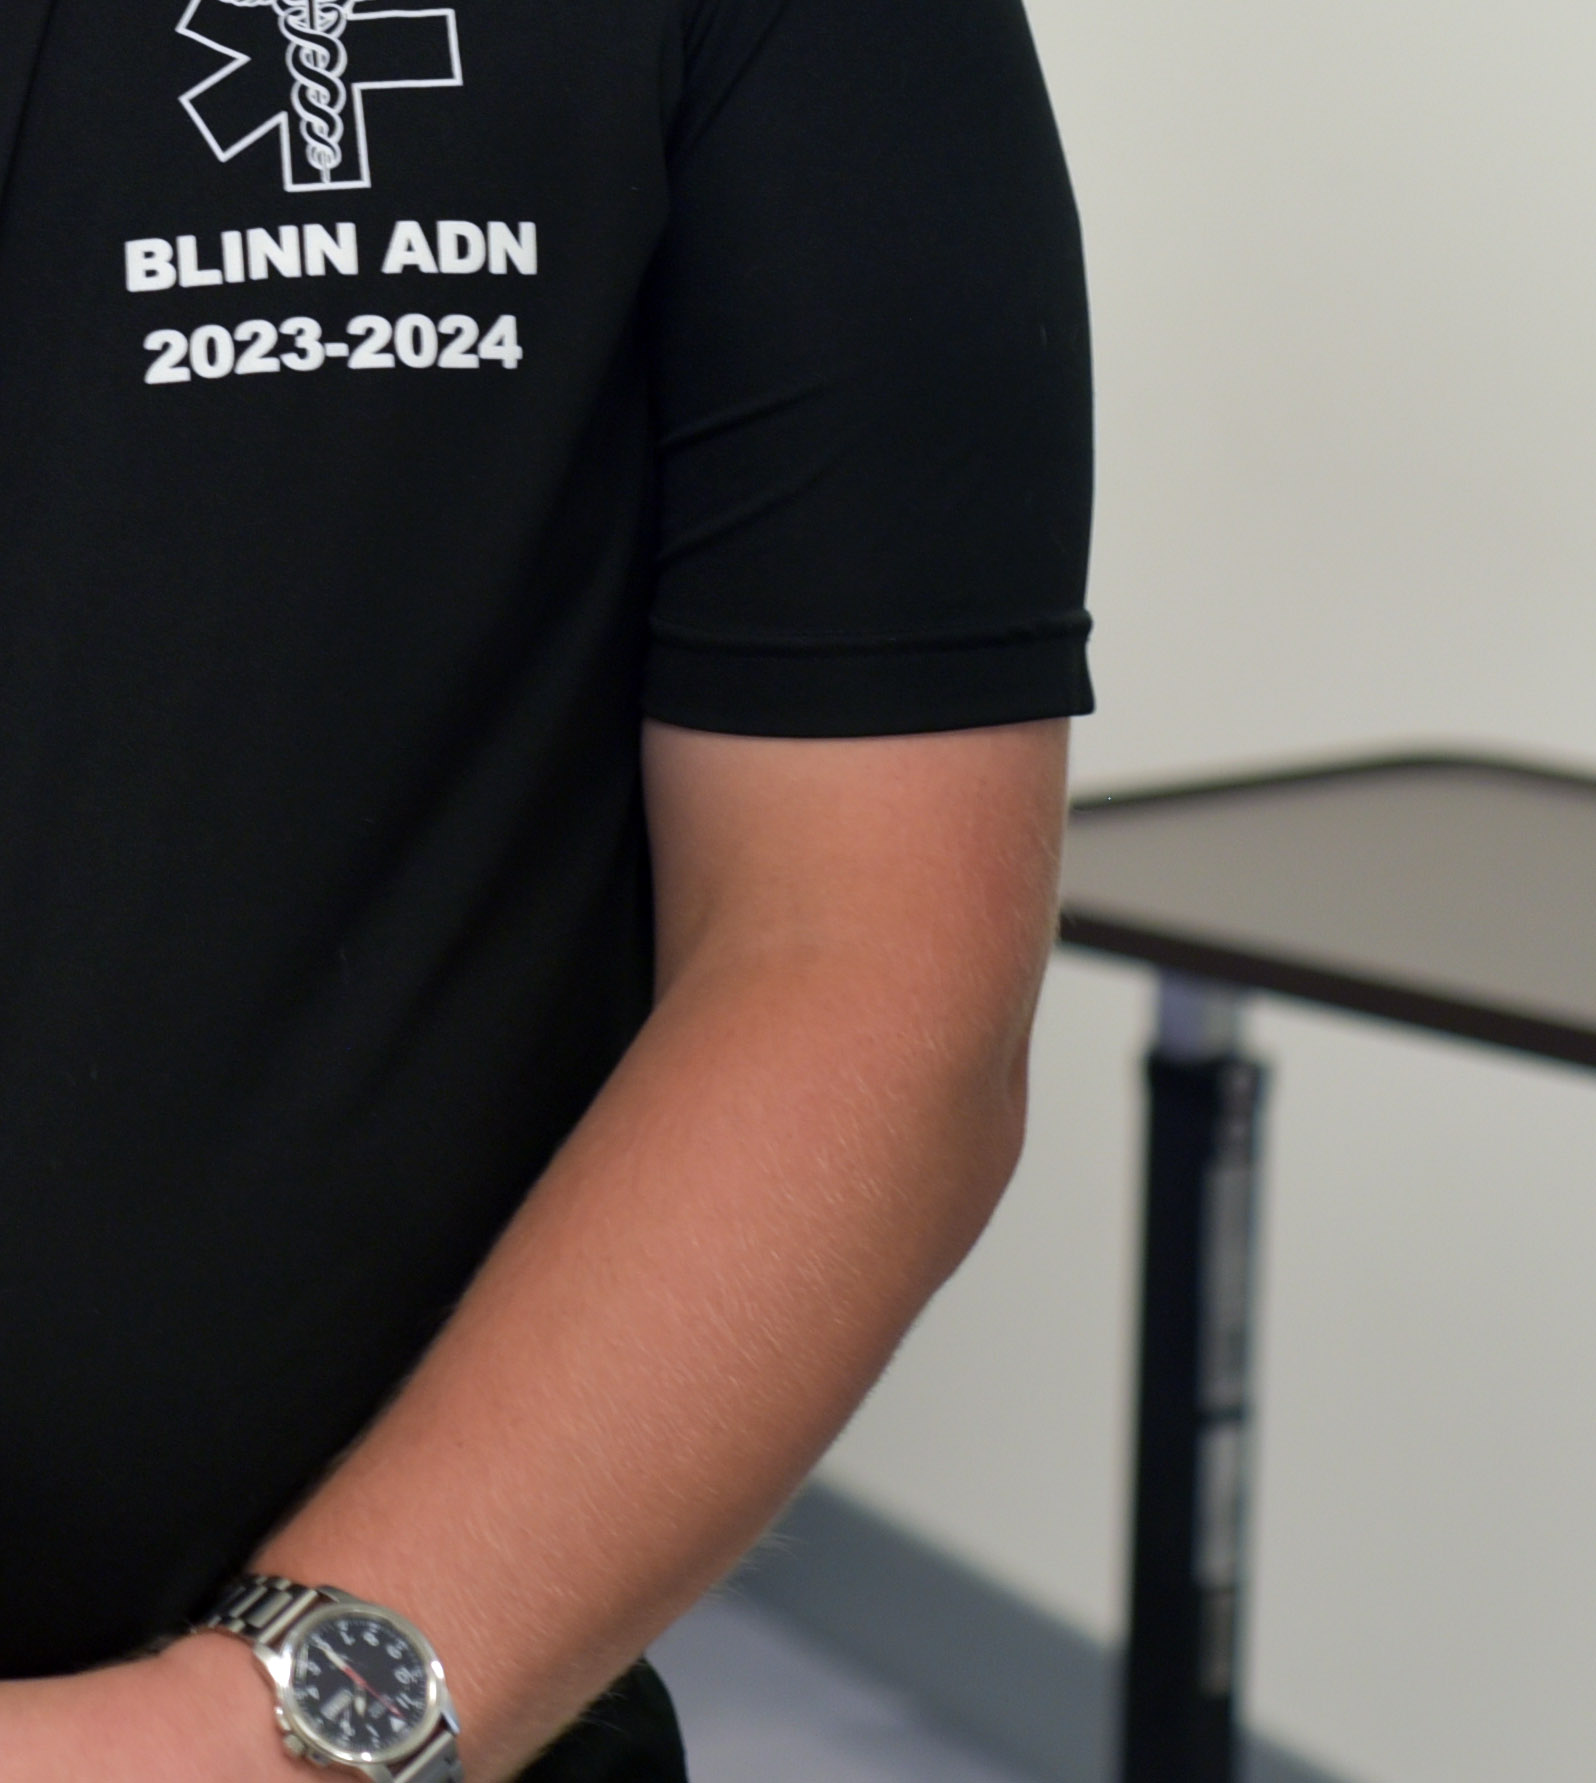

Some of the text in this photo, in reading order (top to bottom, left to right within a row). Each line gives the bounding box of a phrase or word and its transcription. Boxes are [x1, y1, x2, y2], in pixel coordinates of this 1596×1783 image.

[124, 220, 538, 293] BLINN ADN
[143, 313, 523, 385] 2023-2024
